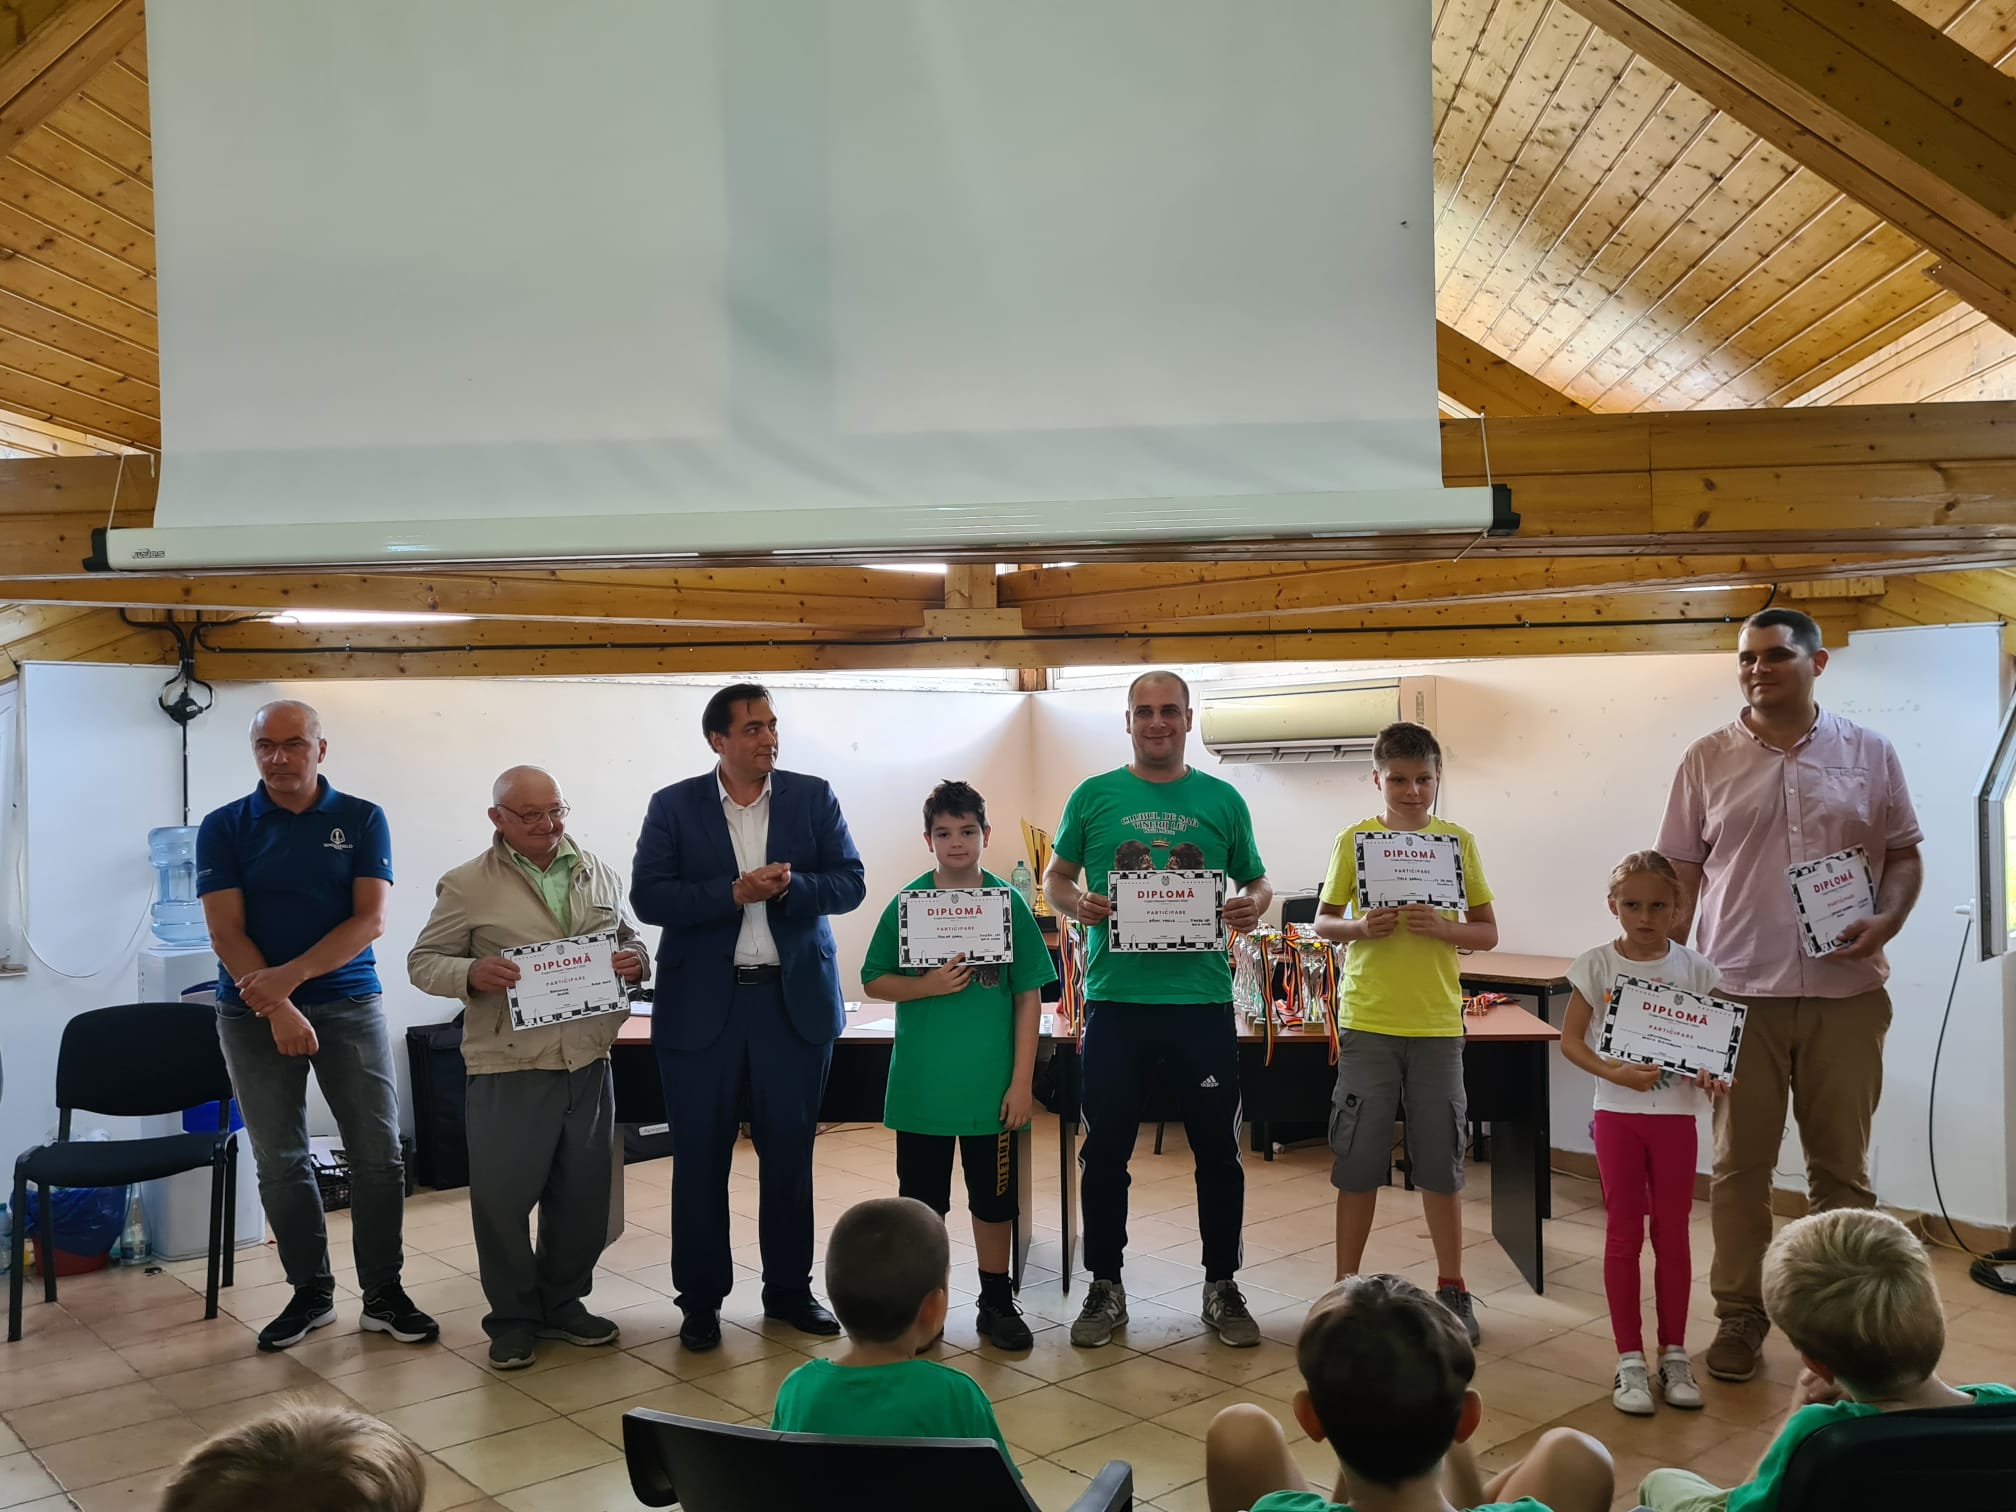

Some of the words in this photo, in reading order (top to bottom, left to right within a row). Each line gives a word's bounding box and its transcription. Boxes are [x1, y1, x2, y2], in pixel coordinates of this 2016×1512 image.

[1161, 812, 1176, 821] DE
[1384, 849, 1436, 859] DIPLOMĂ
[1137, 887, 1195, 899] DIPLOMĂ
[927, 904, 983, 916] DIPLOMĂ
[534, 953, 592, 972] DIPLOMĂ
[546, 976, 586, 986] PARTICIPARE
[1642, 1001, 1709, 1026] DIPLOMĂ
[1648, 1024, 1694, 1040] PARTICIPARE
